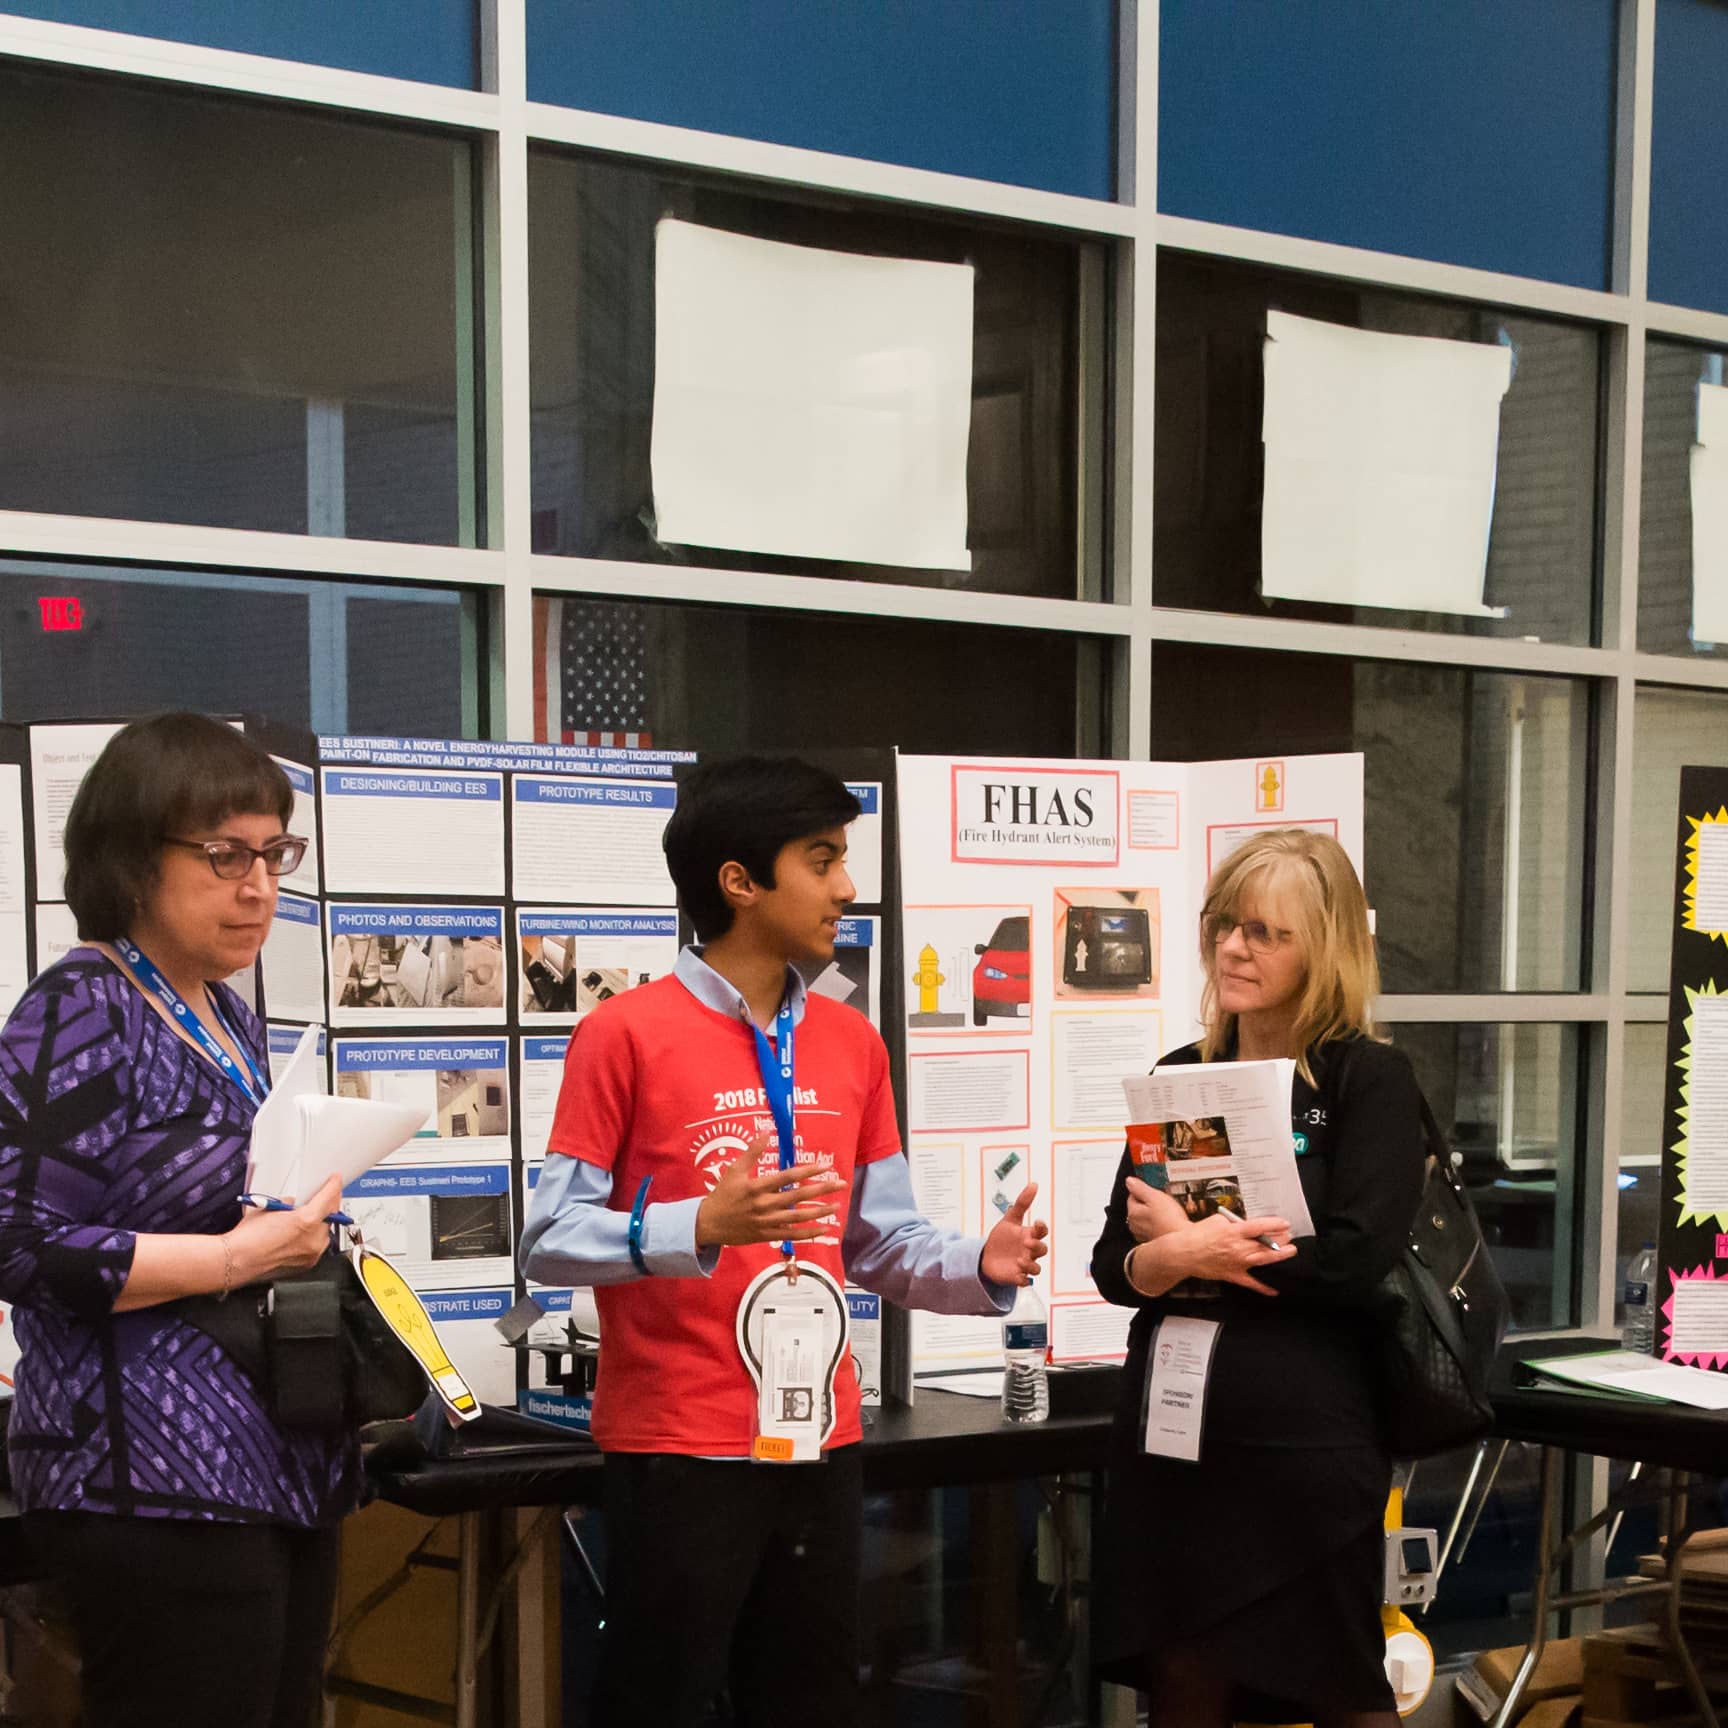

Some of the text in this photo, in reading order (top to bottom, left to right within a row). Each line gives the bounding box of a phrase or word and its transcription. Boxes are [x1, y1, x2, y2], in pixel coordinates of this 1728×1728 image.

[319, 737, 340, 748] EES
[403, 740, 413, 750] A
[414, 740, 448, 752] NOVEL
[556, 747, 596, 759] MODULE
[598, 749, 626, 760] USING
[320, 749, 370, 760] PAINT-ON
[373, 752, 441, 765] FABRICATION
[443, 756, 464, 766] AND
[530, 759, 553, 770] FILM
[554, 761, 600, 773] FLEXIBLE
[601, 764, 673, 776] ARCHITECTURE
[340, 777, 488, 795] DESIGNING/BUILDING EES
[539, 785, 653, 803] PROTOTYPE RESULTS
[981, 784, 1095, 828] FHAS
[958, 829, 1116, 849] (Fire Hydrant Alert System)
[338, 914, 497, 928] PHOTOS AND OBSERVATIONS
[589, 920, 633, 931] MONITOR
[633, 921, 676, 931] ANALYSIS
[347, 1048, 500, 1062] PROTOTYPE DEVELOPMENT
[713, 1088, 760, 1111] 2018
[473, 1299, 502, 1311] USED
